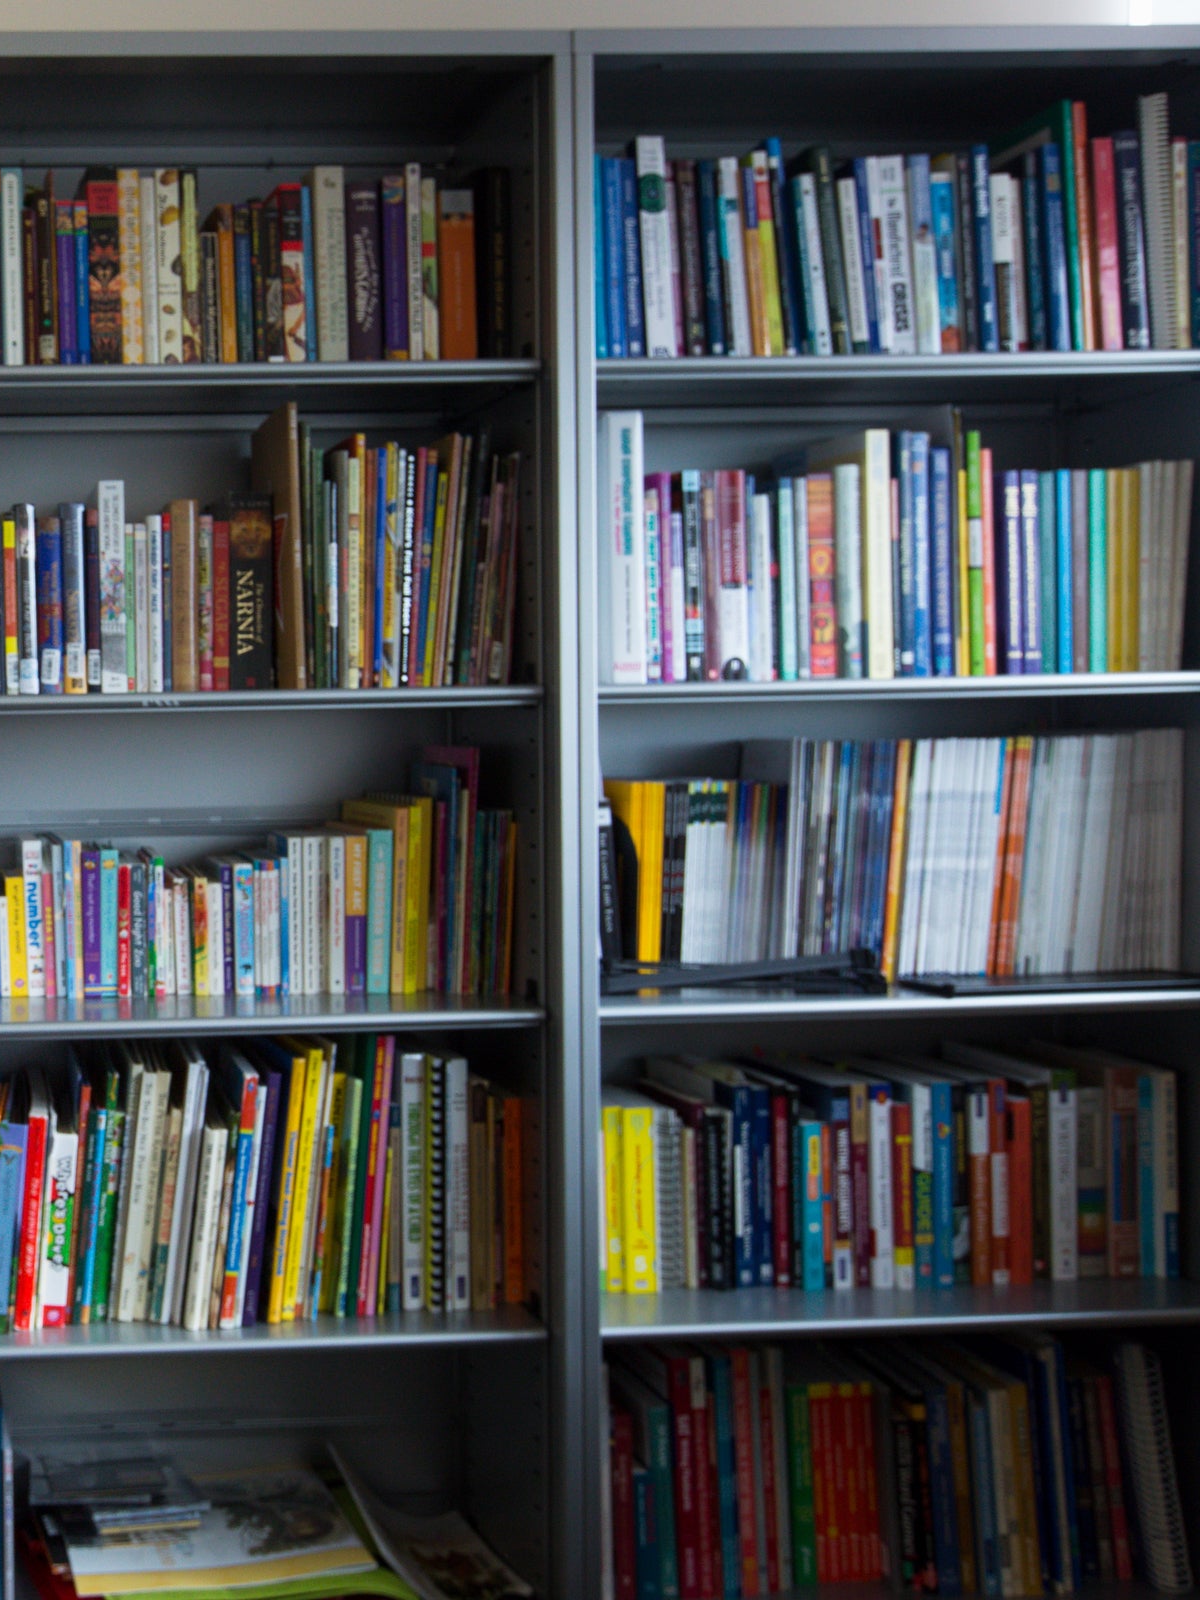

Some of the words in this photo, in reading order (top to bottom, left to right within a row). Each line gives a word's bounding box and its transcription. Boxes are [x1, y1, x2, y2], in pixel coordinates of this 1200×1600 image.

[628, 276, 640, 327] Research
[892, 283, 909, 332] CRISIS
[404, 550, 414, 574] First
[214, 577, 228, 632] SUGAR
[404, 575, 414, 597] Full
[236, 569, 254, 656] NARNIA
[255, 598, 265, 636] Chronicles
[403, 597, 413, 627] Moon
[256, 637, 265, 645] of
[352, 843, 363, 859] MY
[352, 861, 363, 887] FIRST
[27, 882, 43, 949] number
[352, 890, 363, 911] ABC
[132, 917, 145, 945] Night
[239, 902, 252, 958] Animals
[408, 1102, 422, 1146] THROUGH
[408, 1149, 421, 1168] THE
[837, 1128, 850, 1172] WRITING
[837, 1174, 850, 1234] ARGUMENTS
[916, 1172, 931, 1231] GUIDE
[409, 1216, 421, 1244] CHILD
